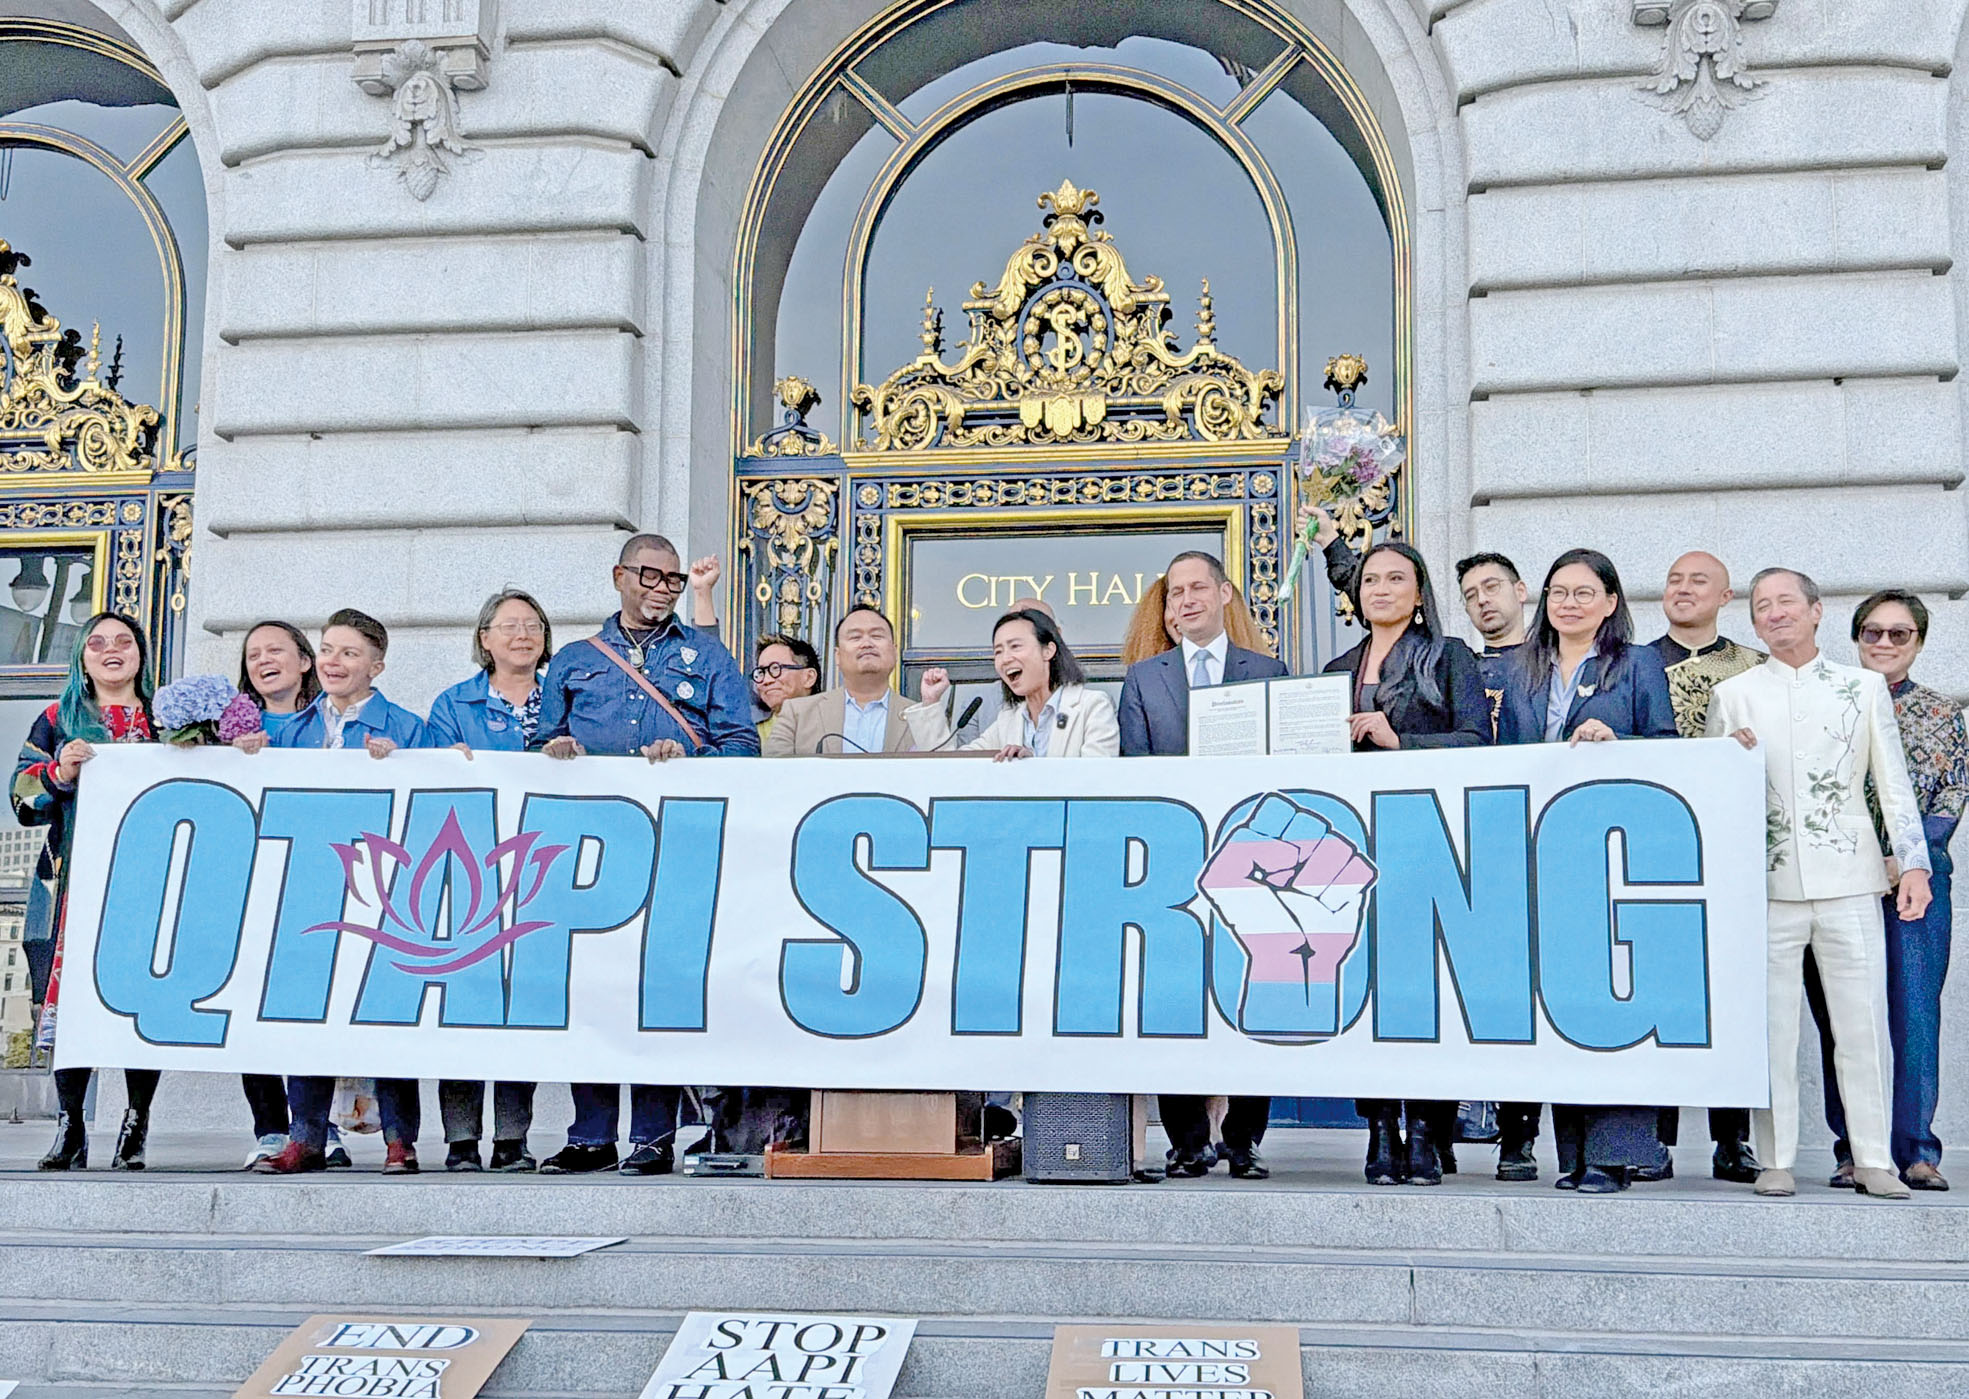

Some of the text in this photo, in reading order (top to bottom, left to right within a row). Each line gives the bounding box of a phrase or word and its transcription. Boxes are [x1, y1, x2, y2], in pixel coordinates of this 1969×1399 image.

[956, 571, 1167, 609] CITY HAL
[93, 777, 1713, 1052] QTAPI STRONG
[325, 1323, 475, 1349] END
[707, 1319, 887, 1354] STOP
[1104, 1340, 1258, 1358] TRANS
[297, 1356, 447, 1379] TRANS
[681, 1351, 866, 1384] AAPI
[1113, 1364, 1248, 1383] LIVES
[274, 1374, 441, 1399] PHOBIA
